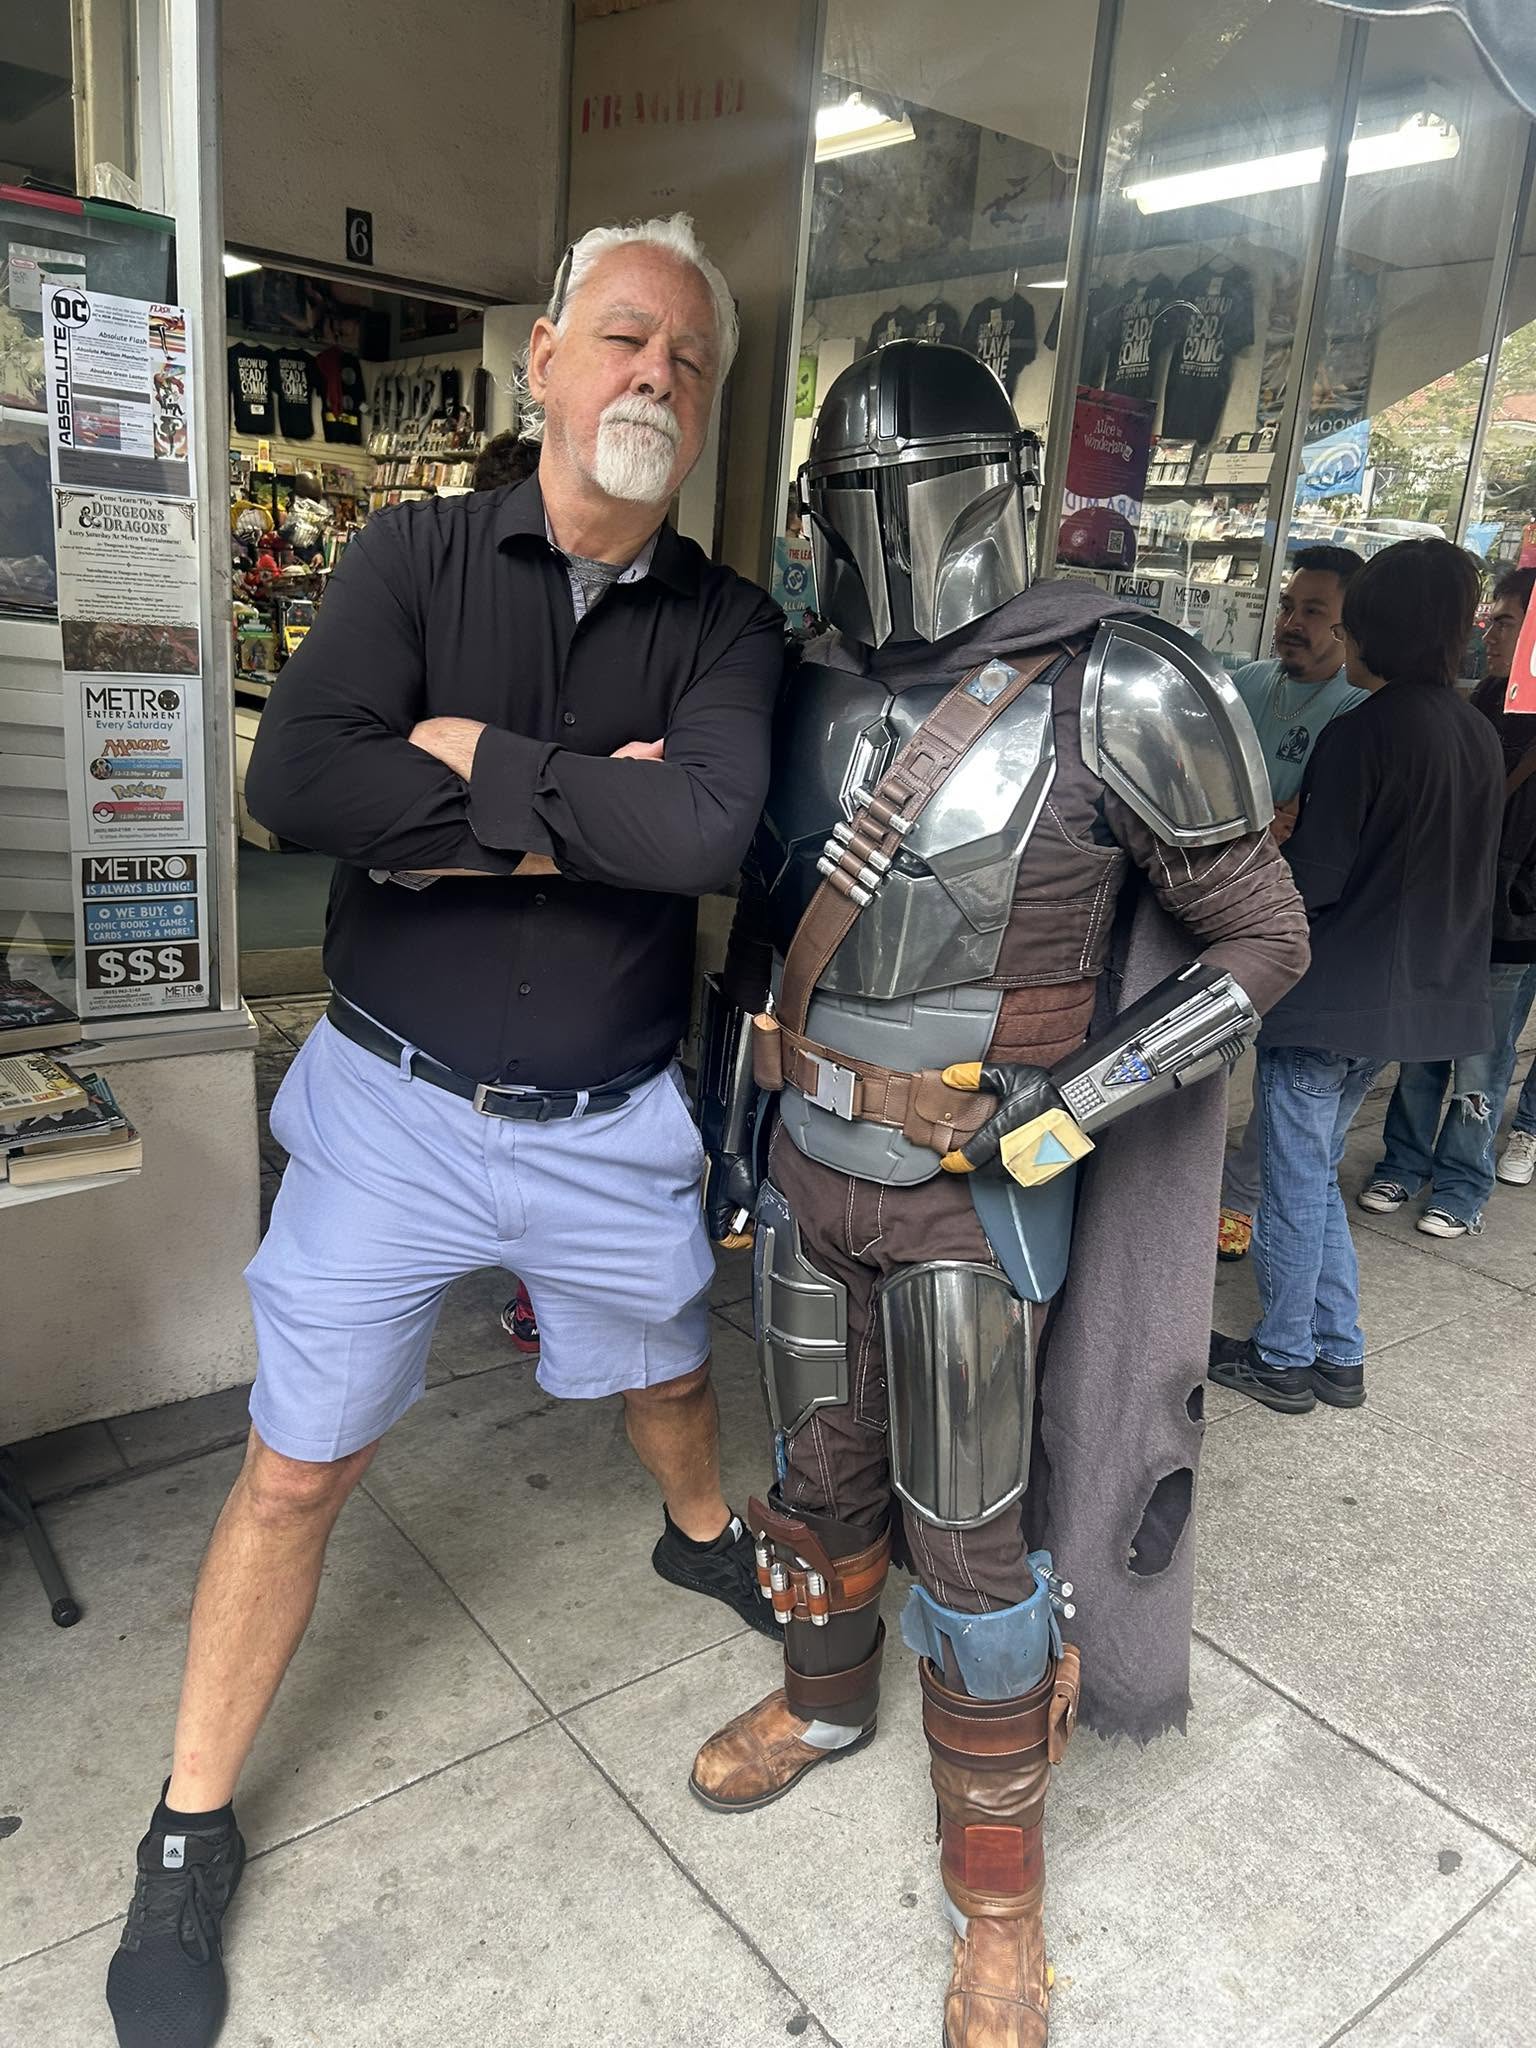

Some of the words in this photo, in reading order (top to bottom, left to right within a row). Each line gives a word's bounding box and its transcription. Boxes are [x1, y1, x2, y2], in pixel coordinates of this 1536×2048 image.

[349, 217, 369, 257] 6
[54, 296, 87, 324] DC
[99, 331, 128, 341] Absolute
[129, 336, 148, 345] Flash
[1183, 337, 1224, 363] COMIC
[238, 357, 258, 368] GROW
[259, 359, 268, 369] UP
[239, 368, 262, 381] READ
[262, 370, 268, 383] A
[54, 325, 72, 446] ABSOLUTE
[241, 380, 268, 395] COMIC
[1094, 420, 1116, 437] Alice
[92, 501, 165, 521] DUNGEONS
[79, 506, 101, 528] &
[103, 517, 168, 535] DRAGONS
[788, 549, 800, 560] THE
[1117, 577, 1160, 597] METRO
[1174, 586, 1211, 604] METRO
[782, 602, 796, 611] ALL
[86, 687, 181, 711] METRO
[86, 711, 181, 720] ENTERTAINMENT
[96, 720, 125, 731] Every
[127, 721, 173, 732] Saturday
[101, 738, 171, 757] MAGIC
[151, 770, 171, 778] Free
[152, 812, 172, 820] Free
[91, 856, 188, 881] METRO
[86, 885, 97, 895] IS
[100, 884, 142, 894] ALWAYS
[146, 881, 191, 893] BUYING!
[115, 907, 136, 918] WE
[140, 906, 168, 917] BUY:
[88, 922, 117, 931] COMIC
[120, 921, 150, 929] BOOKS
[159, 918, 188, 927] GAMES
[93, 931, 122, 940] CARDS
[131, 929, 152, 938] TOYS
[154, 929, 160, 937] &
[163, 927, 191, 937] MORE!
[98, 946, 185, 986] $$$
[165, 984, 204, 996] METRO
